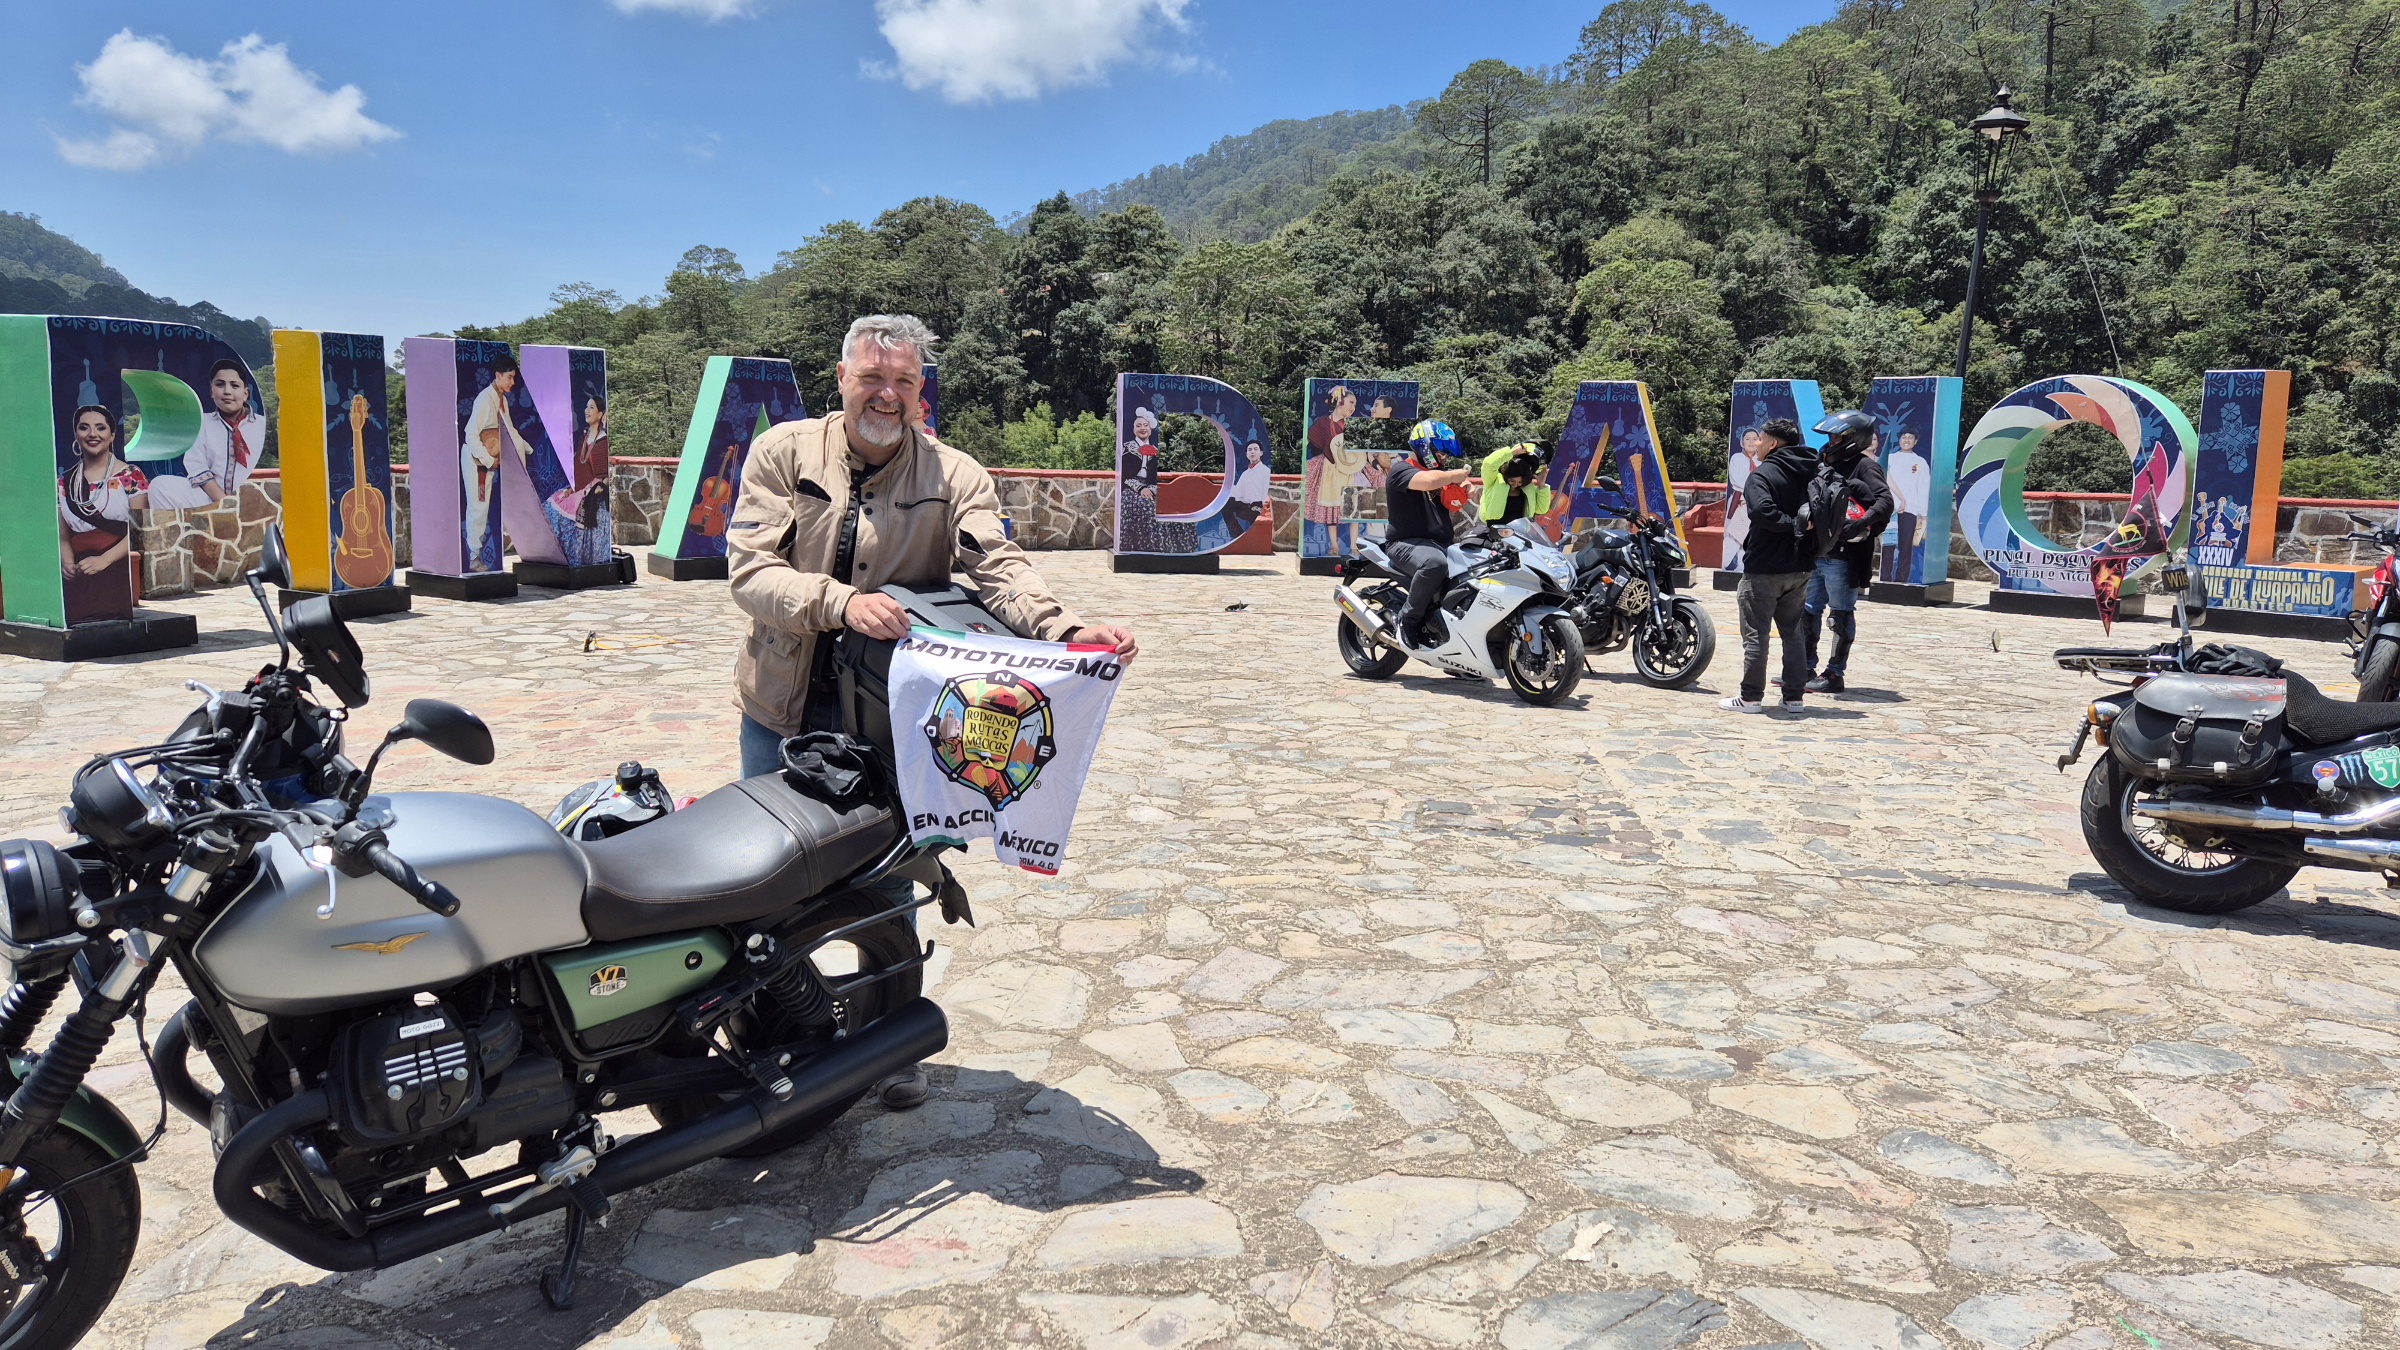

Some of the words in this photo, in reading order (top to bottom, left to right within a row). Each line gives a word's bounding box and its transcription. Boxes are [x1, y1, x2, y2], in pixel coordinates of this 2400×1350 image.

[2198, 546, 2234, 566] XXXIV
[2006, 568, 2055, 581] PUEBLO
[2203, 566, 2253, 579] CONCURSO
[2255, 570, 2304, 582] NACIONAL
[2308, 572, 2321, 583] DE
[2229, 578, 2248, 600] DE
[2251, 577, 2335, 606] HUAPANGO
[2222, 598, 2295, 612] HUASTECO
[898, 638, 1122, 682] MOTOTURISMO
[1437, 656, 1482, 675] SUZUKI
[994, 672, 1012, 683] N
[1038, 745, 1051, 757] E
[2364, 748, 2398, 760] MEXICO
[2373, 759, 2398, 781] 57
[913, 813, 939, 831] EN
[1038, 860, 1055, 871] 4.0
[596, 965, 620, 984] V7
[596, 982, 621, 994] STONE
[401, 1025, 420, 1035] MOTO
